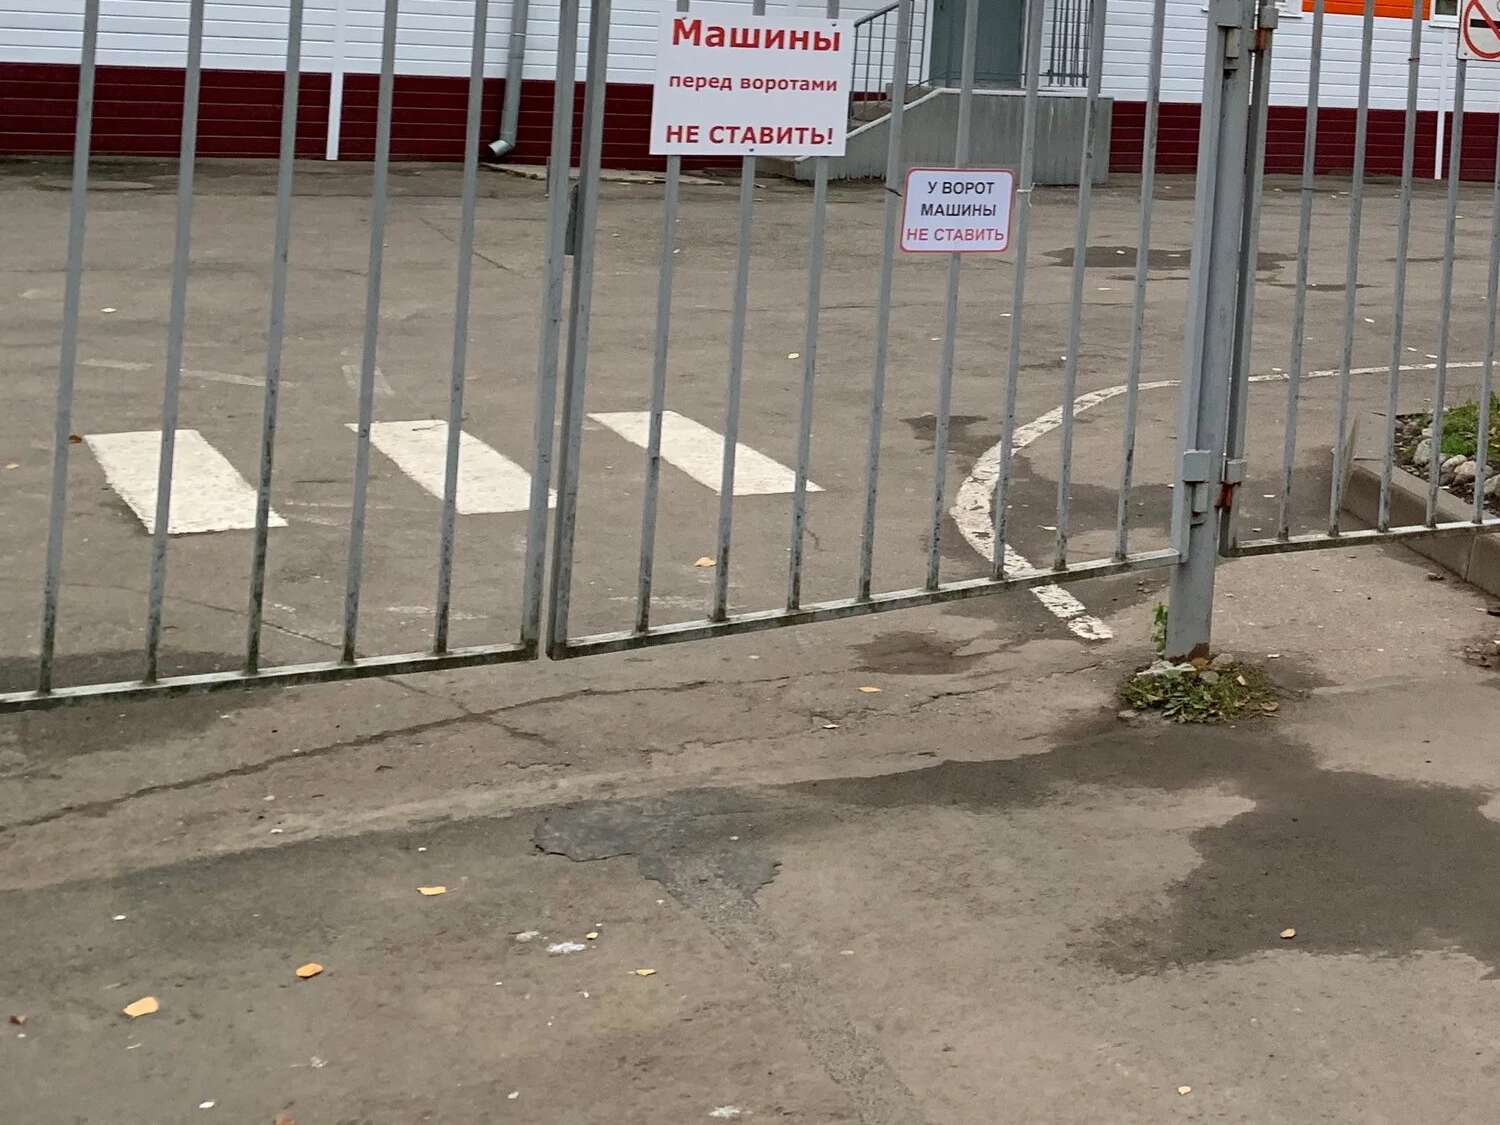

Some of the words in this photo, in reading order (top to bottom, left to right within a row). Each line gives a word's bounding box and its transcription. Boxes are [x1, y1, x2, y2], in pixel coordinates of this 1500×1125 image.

[671, 18, 841, 52] Машины
[668, 75, 733, 92] перед
[739, 77, 838, 94] воротами
[665, 124, 700, 144] НЕ
[708, 125, 834, 146] СТАВИТЬ!
[927, 180, 938, 194] У
[942, 180, 996, 195] ВОРОТ
[919, 202, 997, 217] МАШИНЫ
[906, 227, 928, 242] НЕ
[933, 227, 1005, 242] СТАВИТЬ
